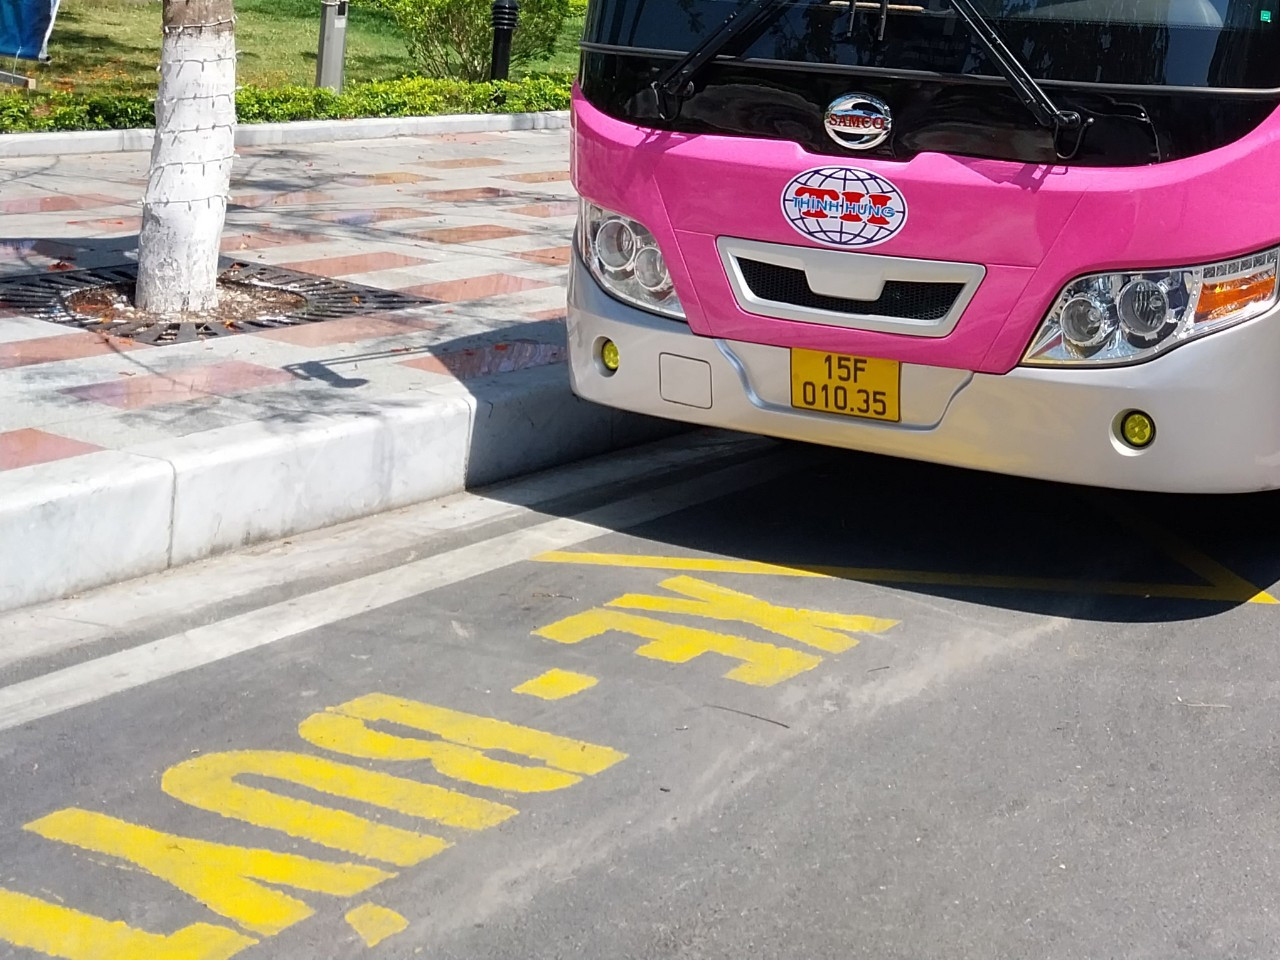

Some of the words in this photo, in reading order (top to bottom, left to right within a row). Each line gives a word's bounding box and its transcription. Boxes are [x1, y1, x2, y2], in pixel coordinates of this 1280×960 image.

[829, 113, 884, 130] SAMCO
[824, 354, 867, 383] 15F
[803, 381, 887, 416] 010.35
